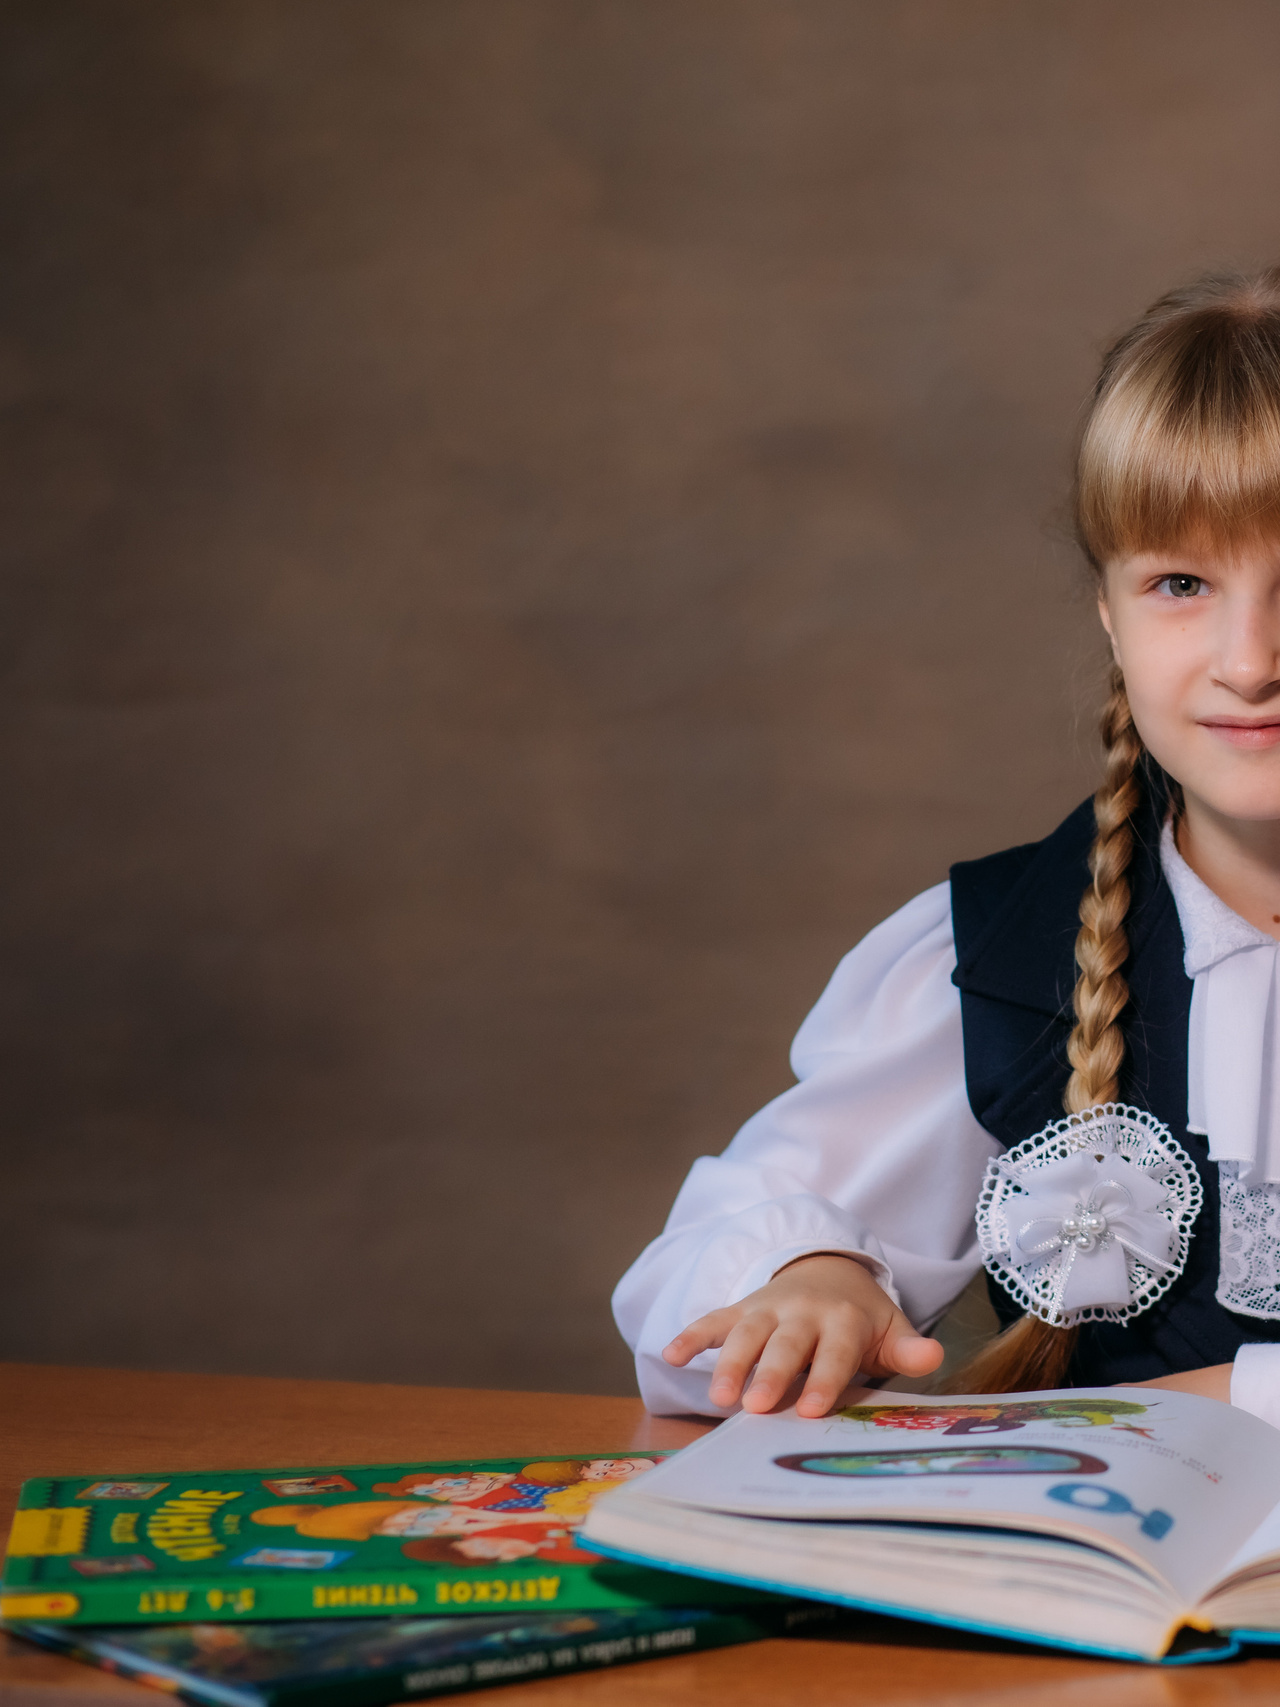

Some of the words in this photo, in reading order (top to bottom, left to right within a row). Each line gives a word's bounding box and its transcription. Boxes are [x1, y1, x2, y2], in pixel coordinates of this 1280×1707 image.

[146, 1489, 244, 1562] ЧТЕНИЕ
[138, 1590, 189, 1614] ЛЕТ
[312, 1584, 418, 1608] ЧТЕНИЕ
[436, 1576, 560, 1604] ДЕТСКОЕ
